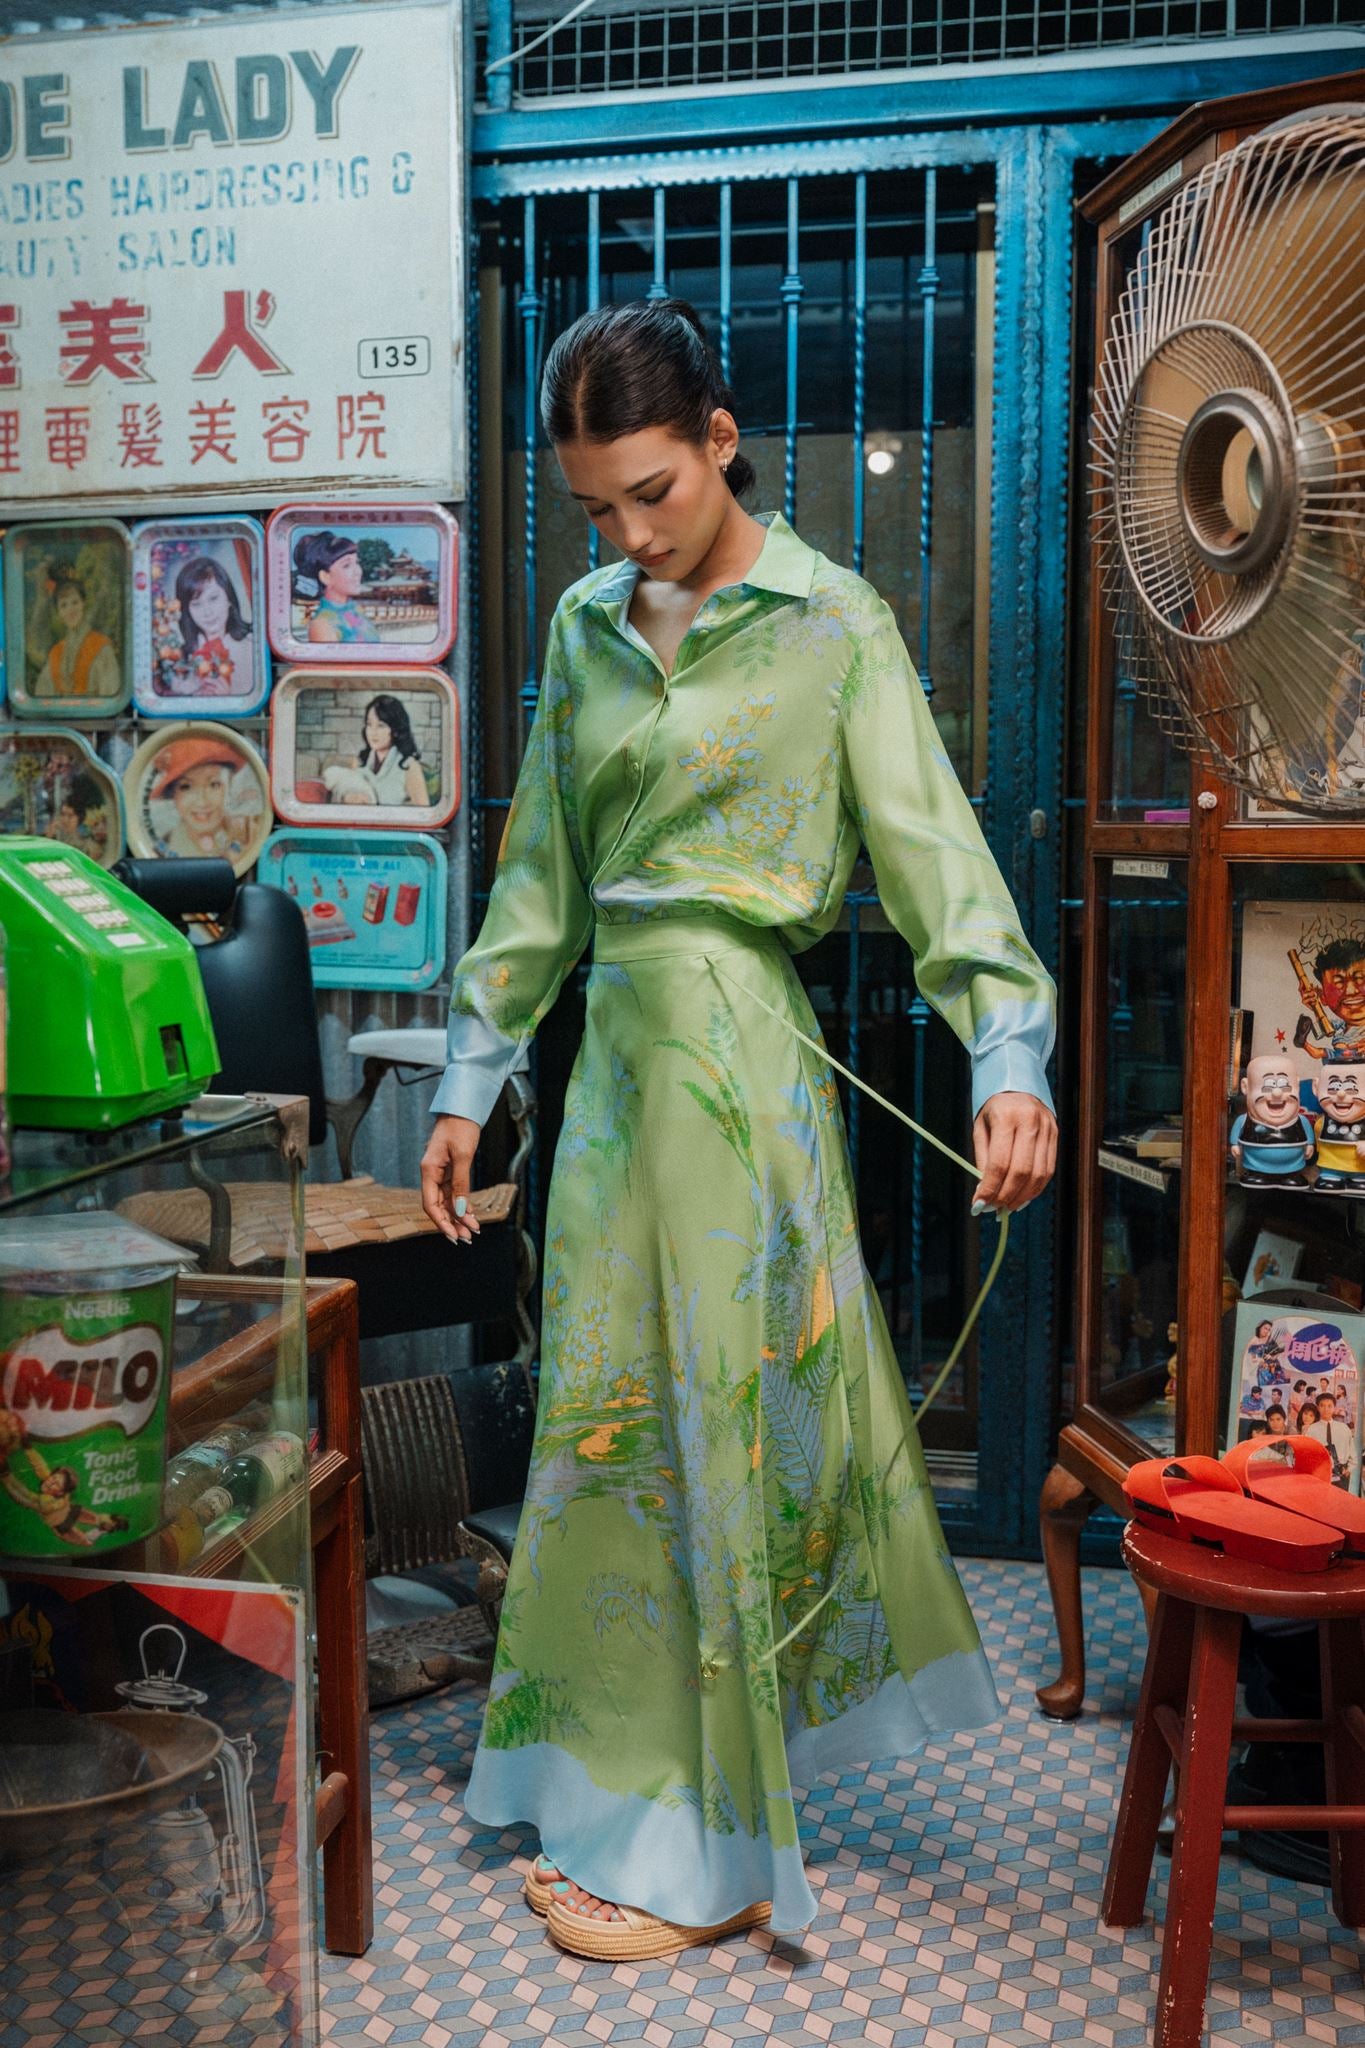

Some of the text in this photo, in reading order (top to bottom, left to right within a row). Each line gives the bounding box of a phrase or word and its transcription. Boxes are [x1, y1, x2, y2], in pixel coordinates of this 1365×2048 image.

[123, 45, 363, 155] LADY
[118, 226, 237, 272] SALON
[0, 288, 290, 389] 美人
[371, 344, 418, 370] 135
[12, 1350, 158, 1411] MILO
[83, 1448, 137, 1471] Tonic
[88, 1463, 139, 1488] Food
[91, 1482, 142, 1506] Drink
